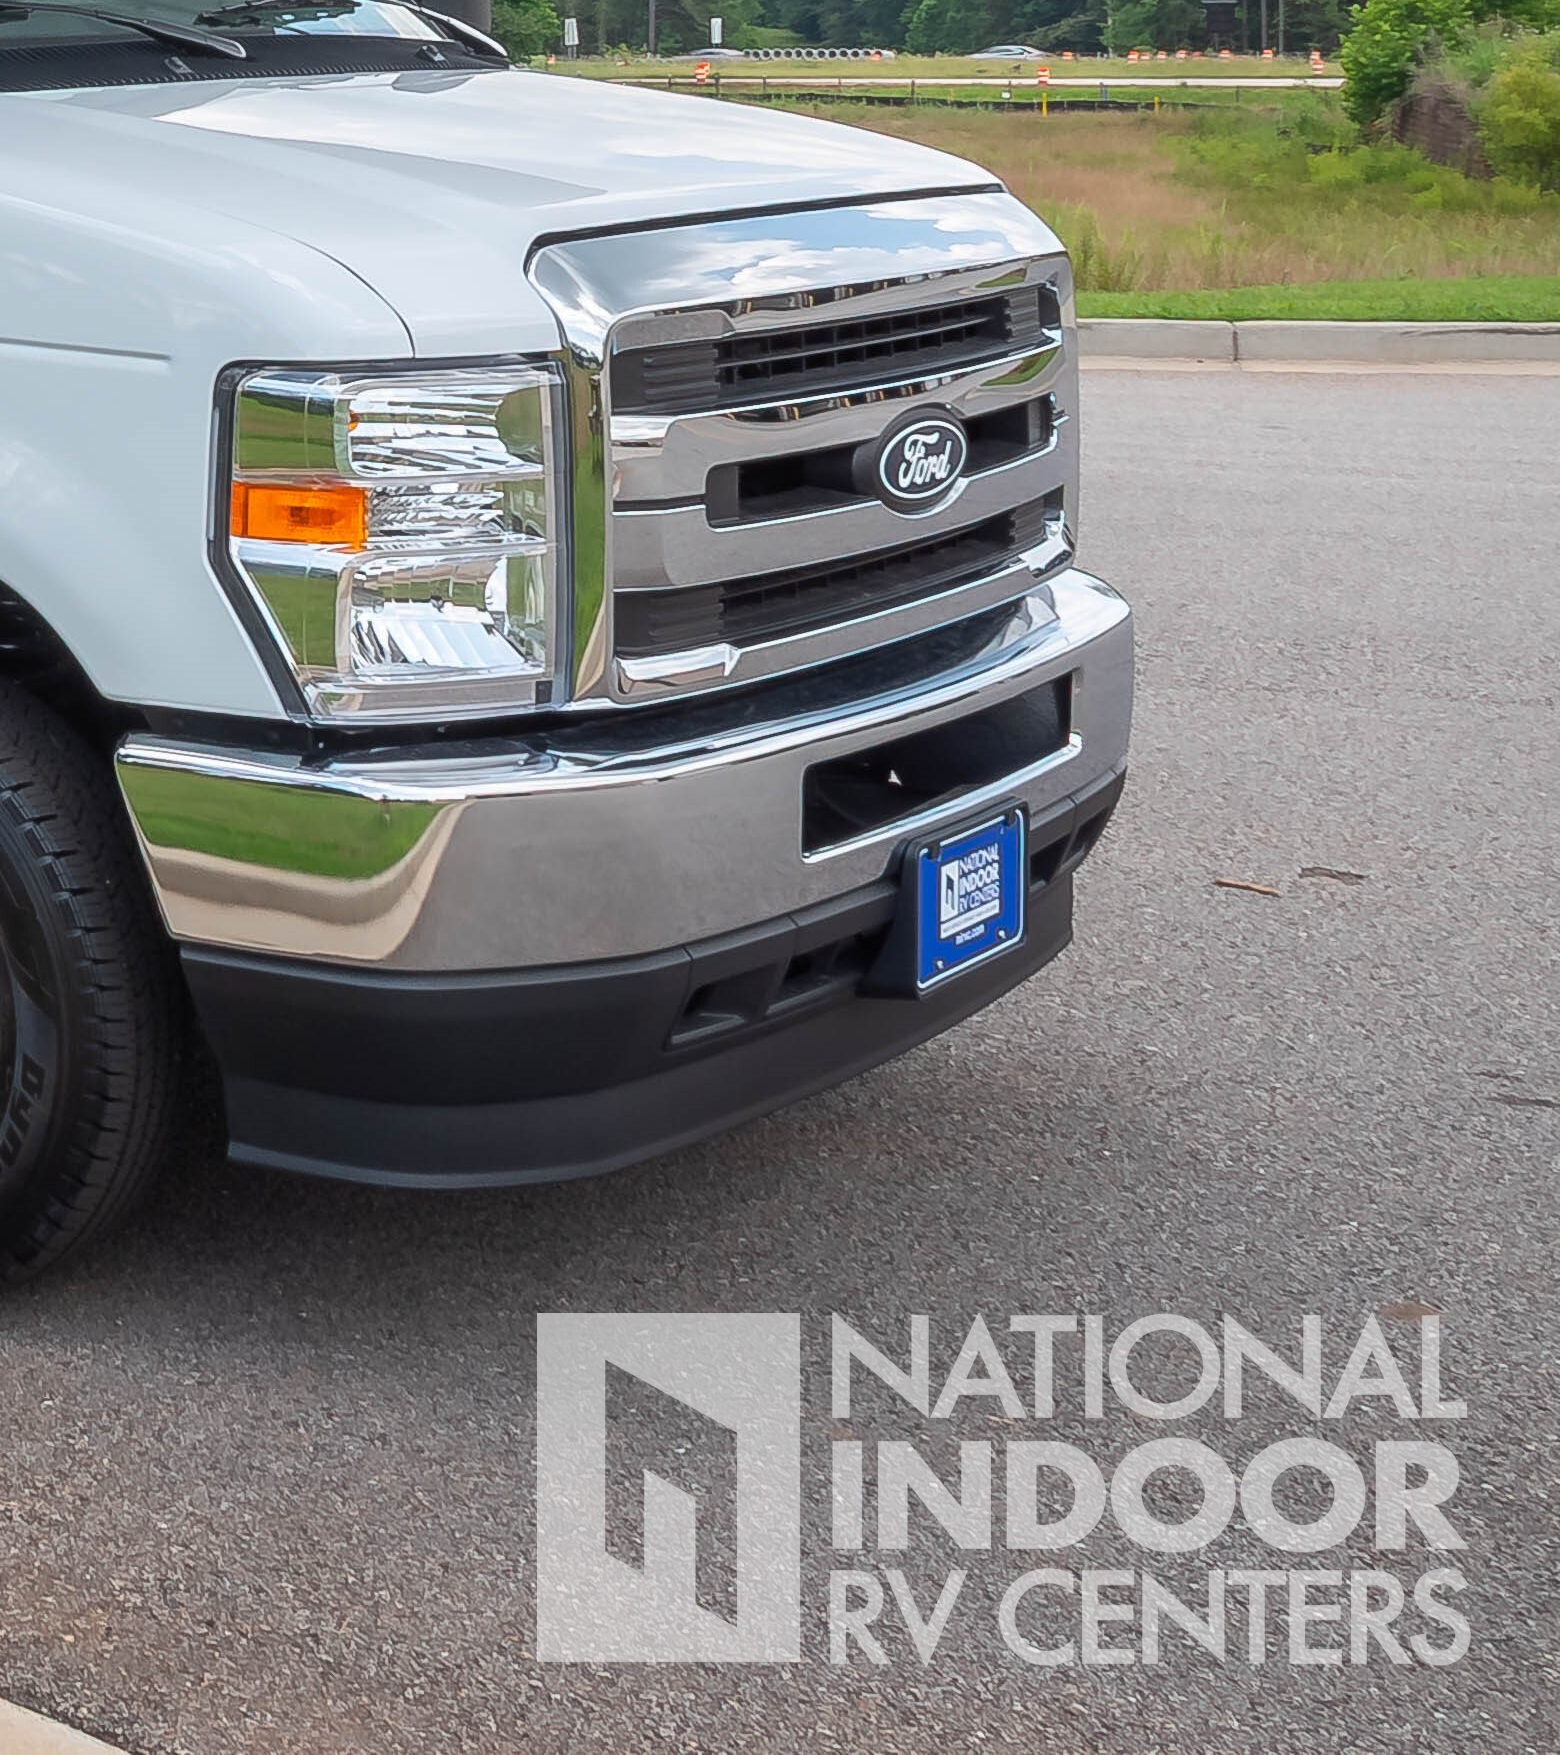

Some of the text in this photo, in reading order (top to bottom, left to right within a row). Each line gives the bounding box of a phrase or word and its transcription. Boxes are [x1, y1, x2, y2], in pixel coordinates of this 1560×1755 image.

[898, 431, 953, 488] Ford
[959, 842, 1000, 875] NATIONAL
[959, 862, 1000, 896] INDOOR
